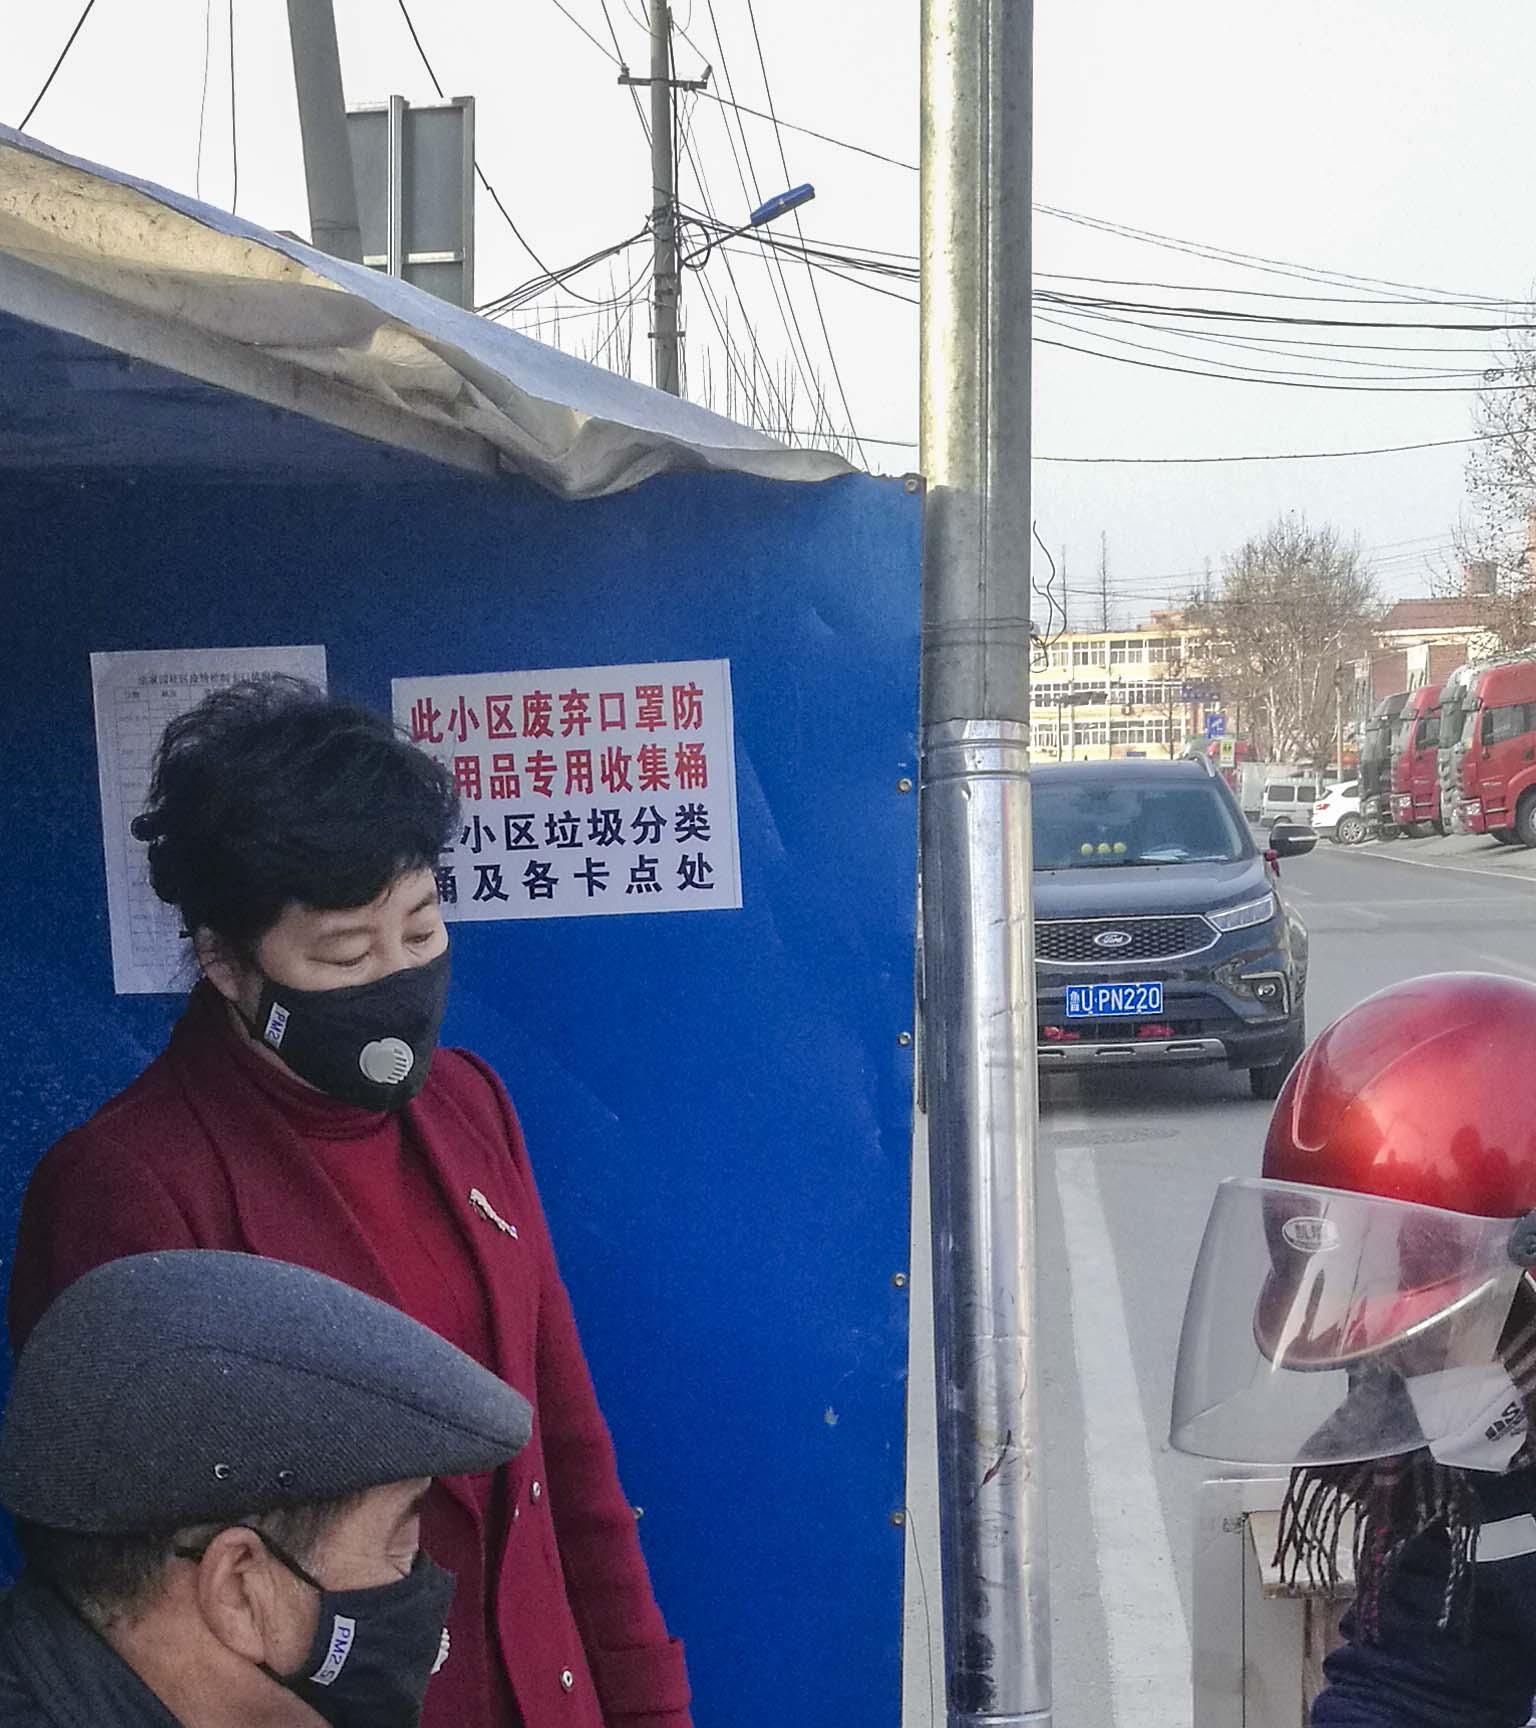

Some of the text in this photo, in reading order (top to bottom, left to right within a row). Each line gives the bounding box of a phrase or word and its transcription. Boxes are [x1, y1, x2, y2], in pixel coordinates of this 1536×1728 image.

[411, 682, 704, 744] 此小区废弃口罩防
[440, 742, 709, 801] 用品专用收集桶
[439, 803, 712, 854] 小区垃圾分类
